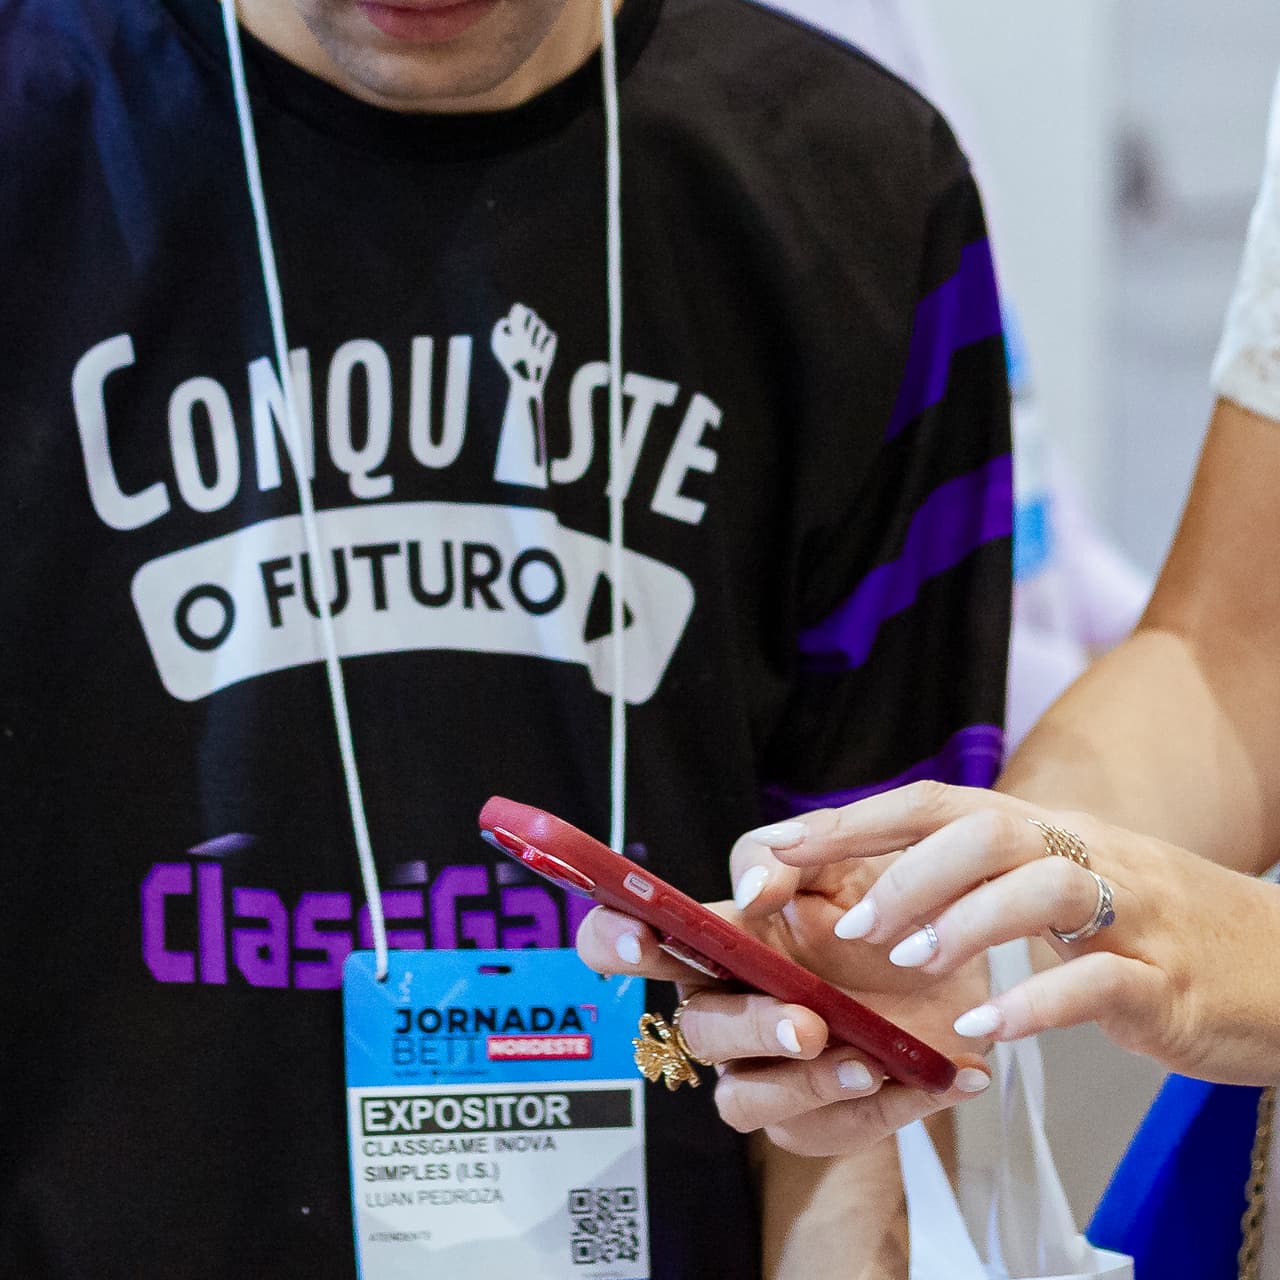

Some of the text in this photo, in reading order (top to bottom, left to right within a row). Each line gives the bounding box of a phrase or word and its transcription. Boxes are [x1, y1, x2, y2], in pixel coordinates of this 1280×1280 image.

[72, 303, 724, 531] CONQUISTE
[173, 540, 567, 653] O FUTURO
[395, 1006, 583, 1035] JORNADA
[393, 1035, 478, 1066] BETT
[363, 1094, 571, 1132] EXPOSITOR
[363, 1135, 557, 1157] CLASSGAME INOVA
[364, 1163, 450, 1182] SIMPLES
[365, 1190, 414, 1207] LUAN
